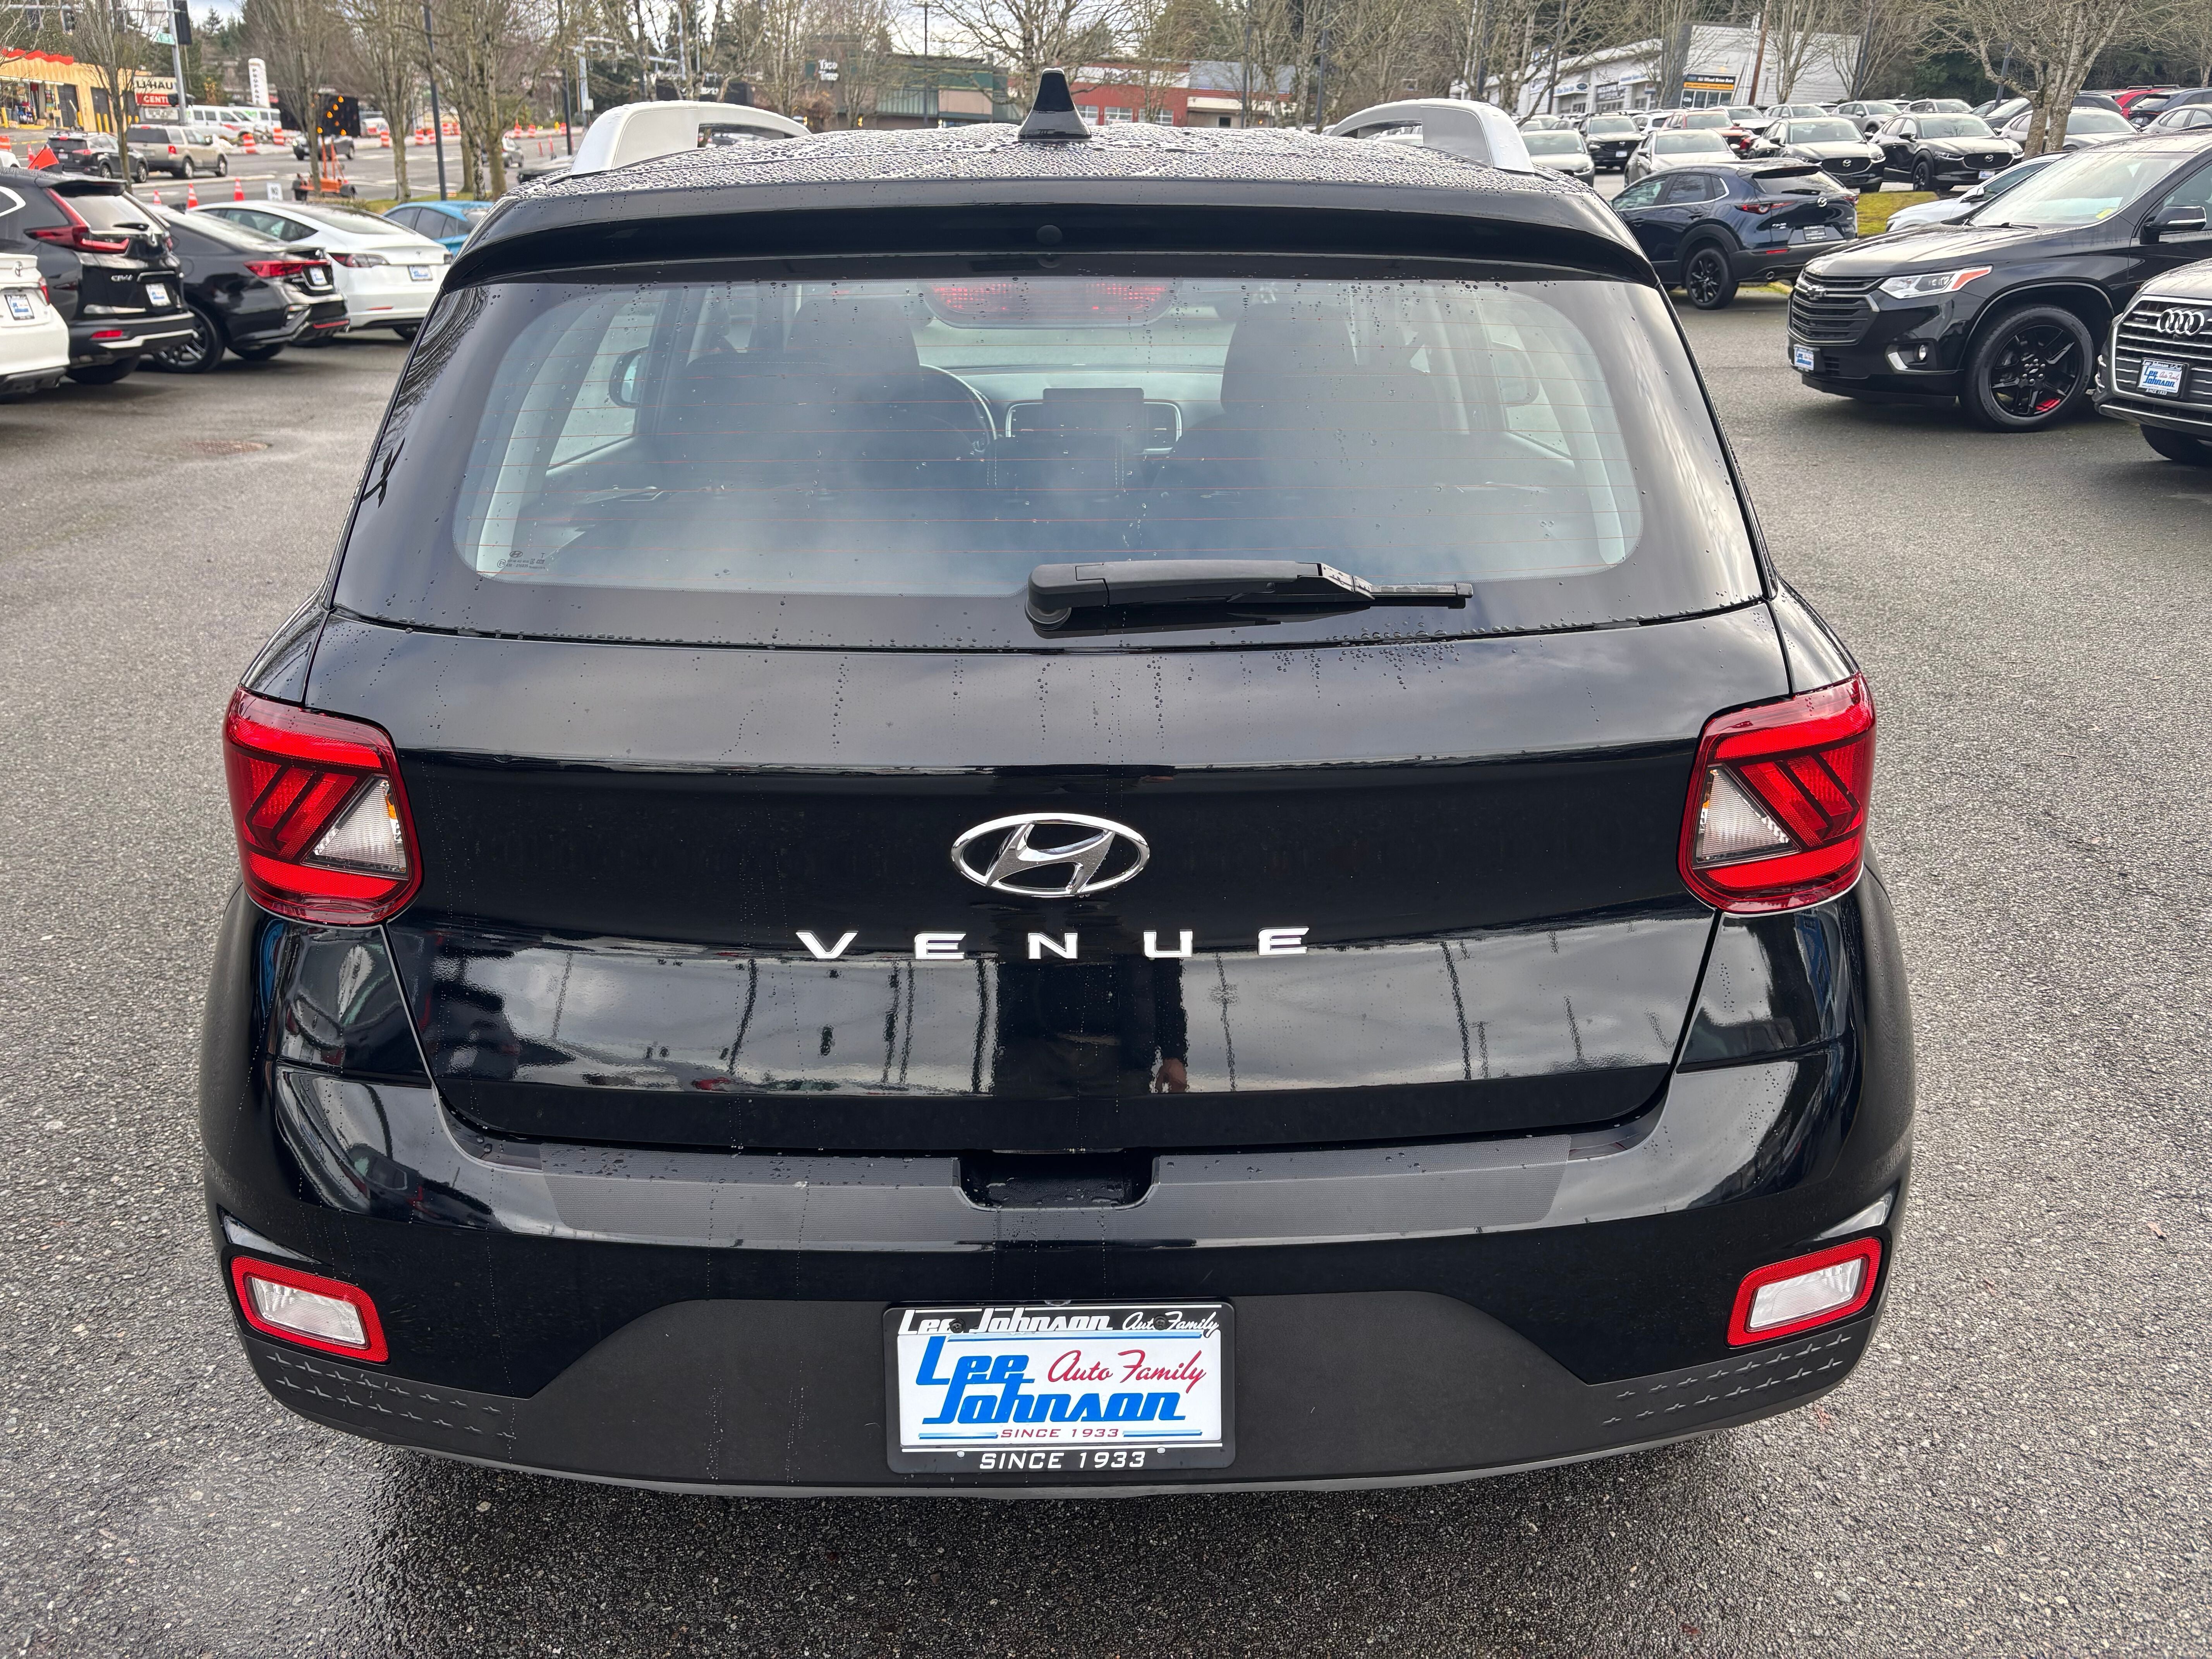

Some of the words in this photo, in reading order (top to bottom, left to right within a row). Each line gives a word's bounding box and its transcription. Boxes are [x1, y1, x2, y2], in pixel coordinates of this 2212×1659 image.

[136, 80, 173, 90] U-HAU
[143, 95, 169, 103] CENT
[2144, 366, 2159, 377] Lee
[2143, 376, 2175, 387] Johnson
[795, 926, 1310, 960] VENUE
[969, 1307, 1114, 1333] Johnson
[1122, 1311, 1159, 1331] Aut
[1164, 1310, 1219, 1338] Family
[915, 1336, 1036, 1386] Lee
[1048, 1350, 1113, 1383] Auto
[1117, 1349, 1206, 1394] Family
[922, 1375, 1186, 1424] Johnson
[1001, 1429, 1061, 1438] SINCE
[1072, 1428, 1119, 1438] 1933
[980, 1452, 1065, 1470] SINCE
[1079, 1451, 1146, 1468] 1933
